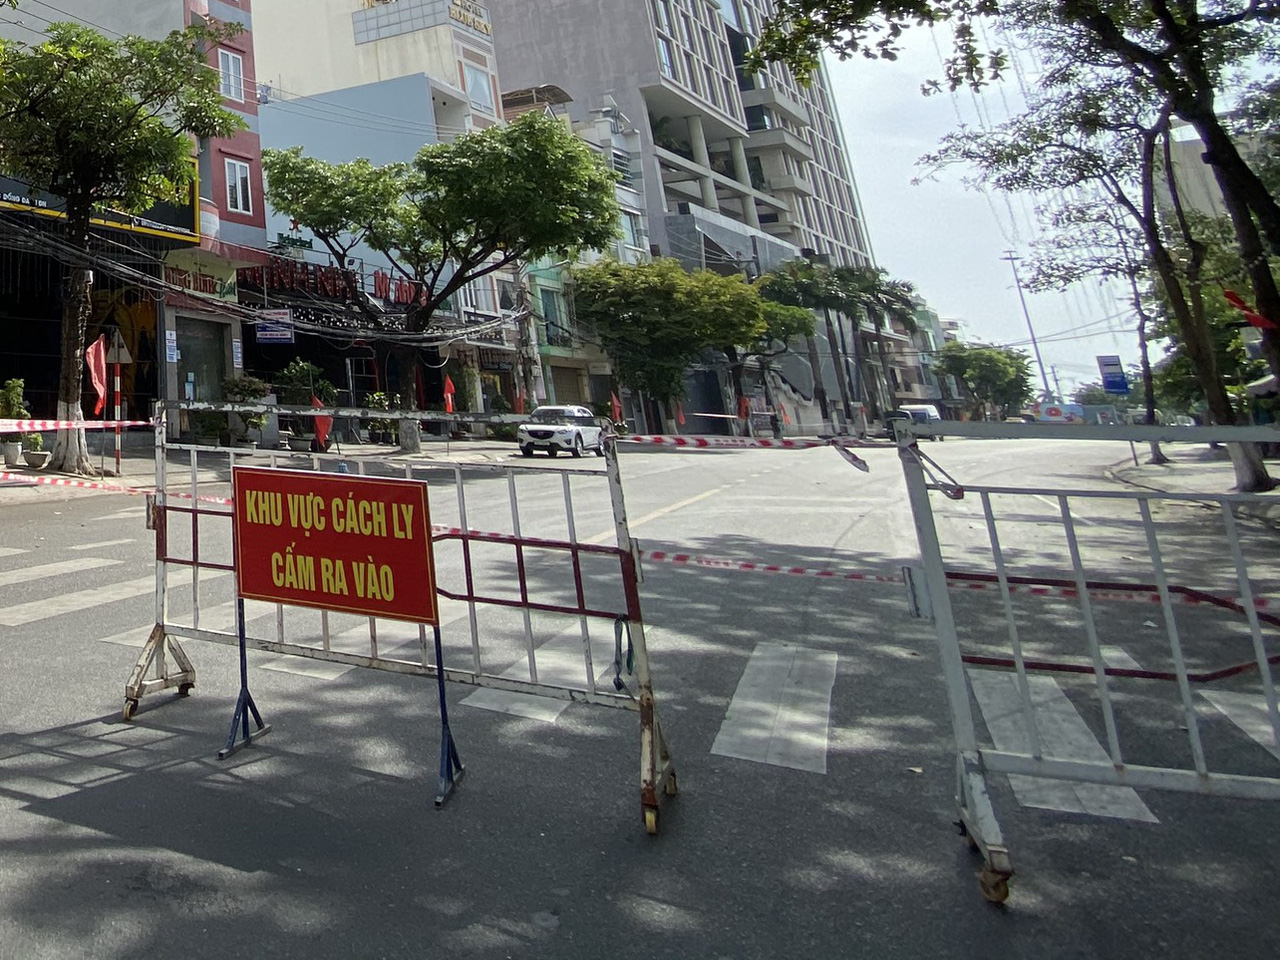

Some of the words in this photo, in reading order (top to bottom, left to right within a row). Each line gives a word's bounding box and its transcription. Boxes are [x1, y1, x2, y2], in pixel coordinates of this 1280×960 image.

[245, 489, 283, 527] KHU
[287, 491, 326, 537] VỰC
[331, 491, 387, 537] CÁCH
[392, 502, 414, 540] LY
[271, 541, 316, 592] CẤM
[320, 556, 348, 596] RA
[352, 555, 395, 602] VÀO
